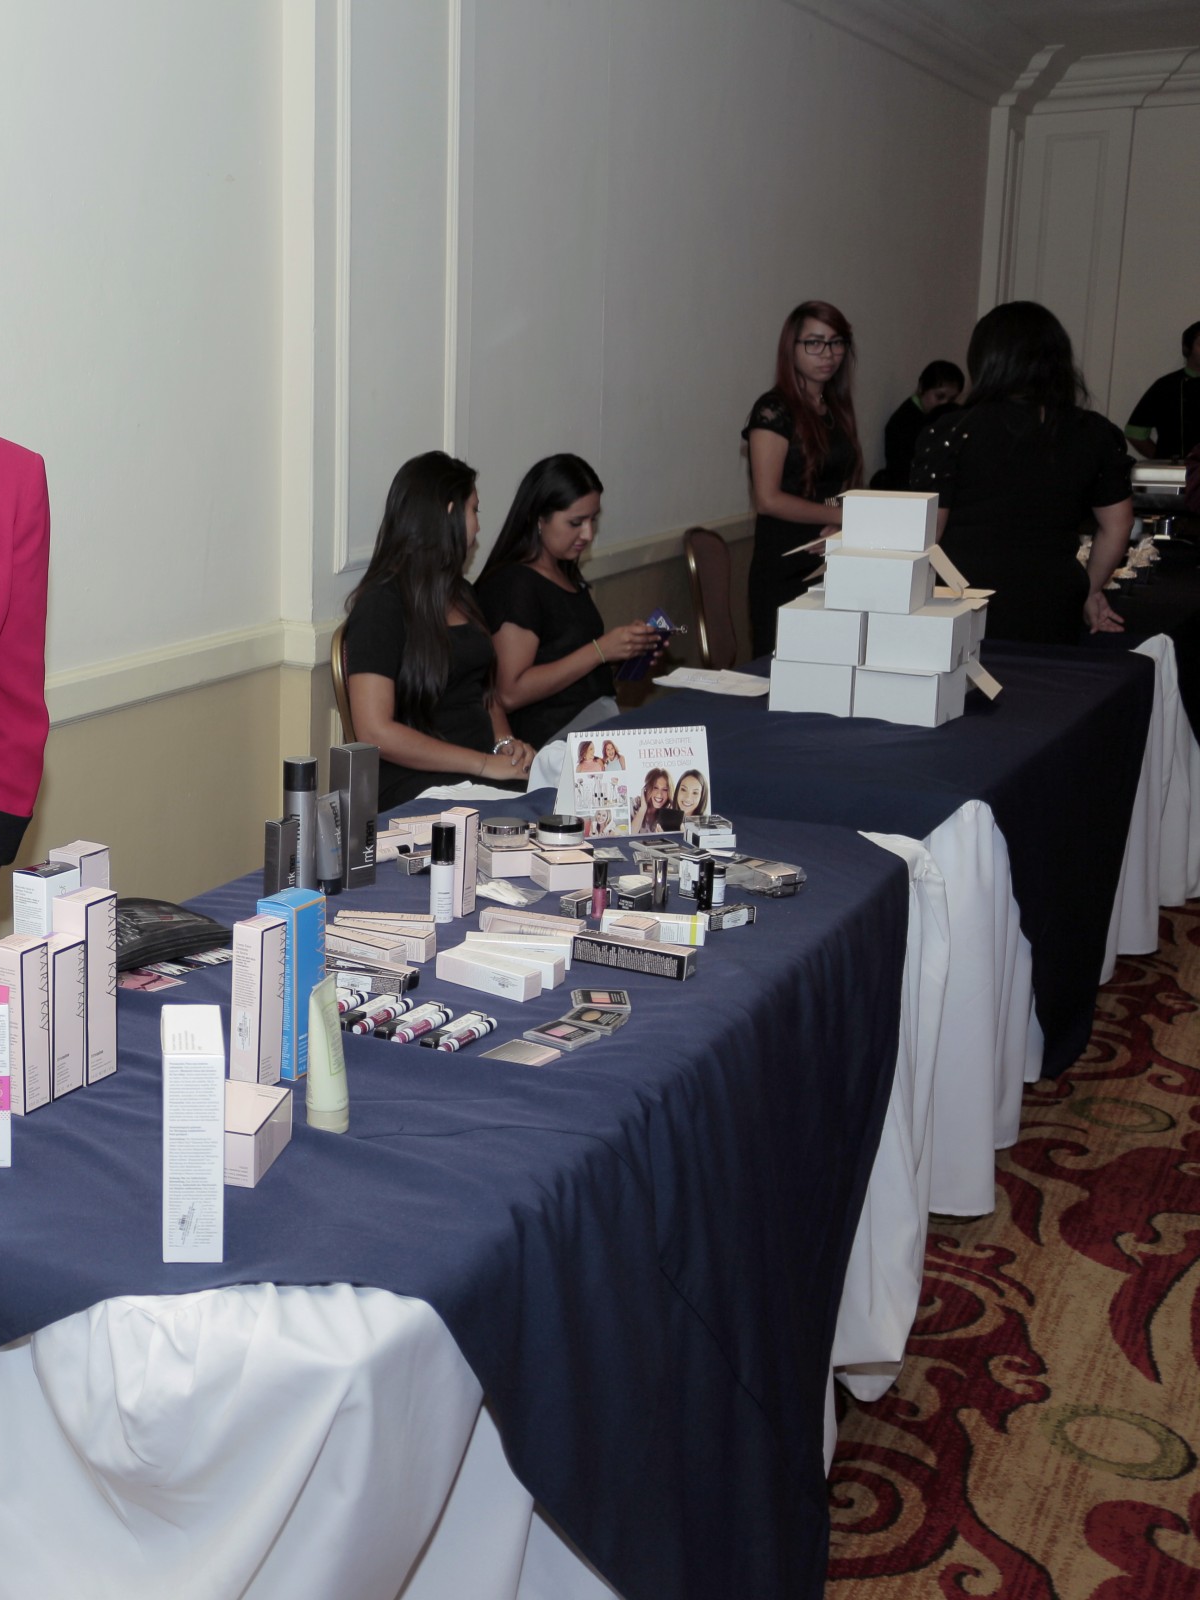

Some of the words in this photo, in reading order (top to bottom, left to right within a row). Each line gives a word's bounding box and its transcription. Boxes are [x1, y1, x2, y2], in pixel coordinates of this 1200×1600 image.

[639, 747, 693, 758] HERMOSA
[106, 897, 117, 953] MARY
[39, 945, 48, 992] MARY
[76, 943, 84, 984] MARY
[106, 962, 117, 998] KAY
[38, 1000, 50, 1031] KAY
[76, 992, 84, 1018] KAY
